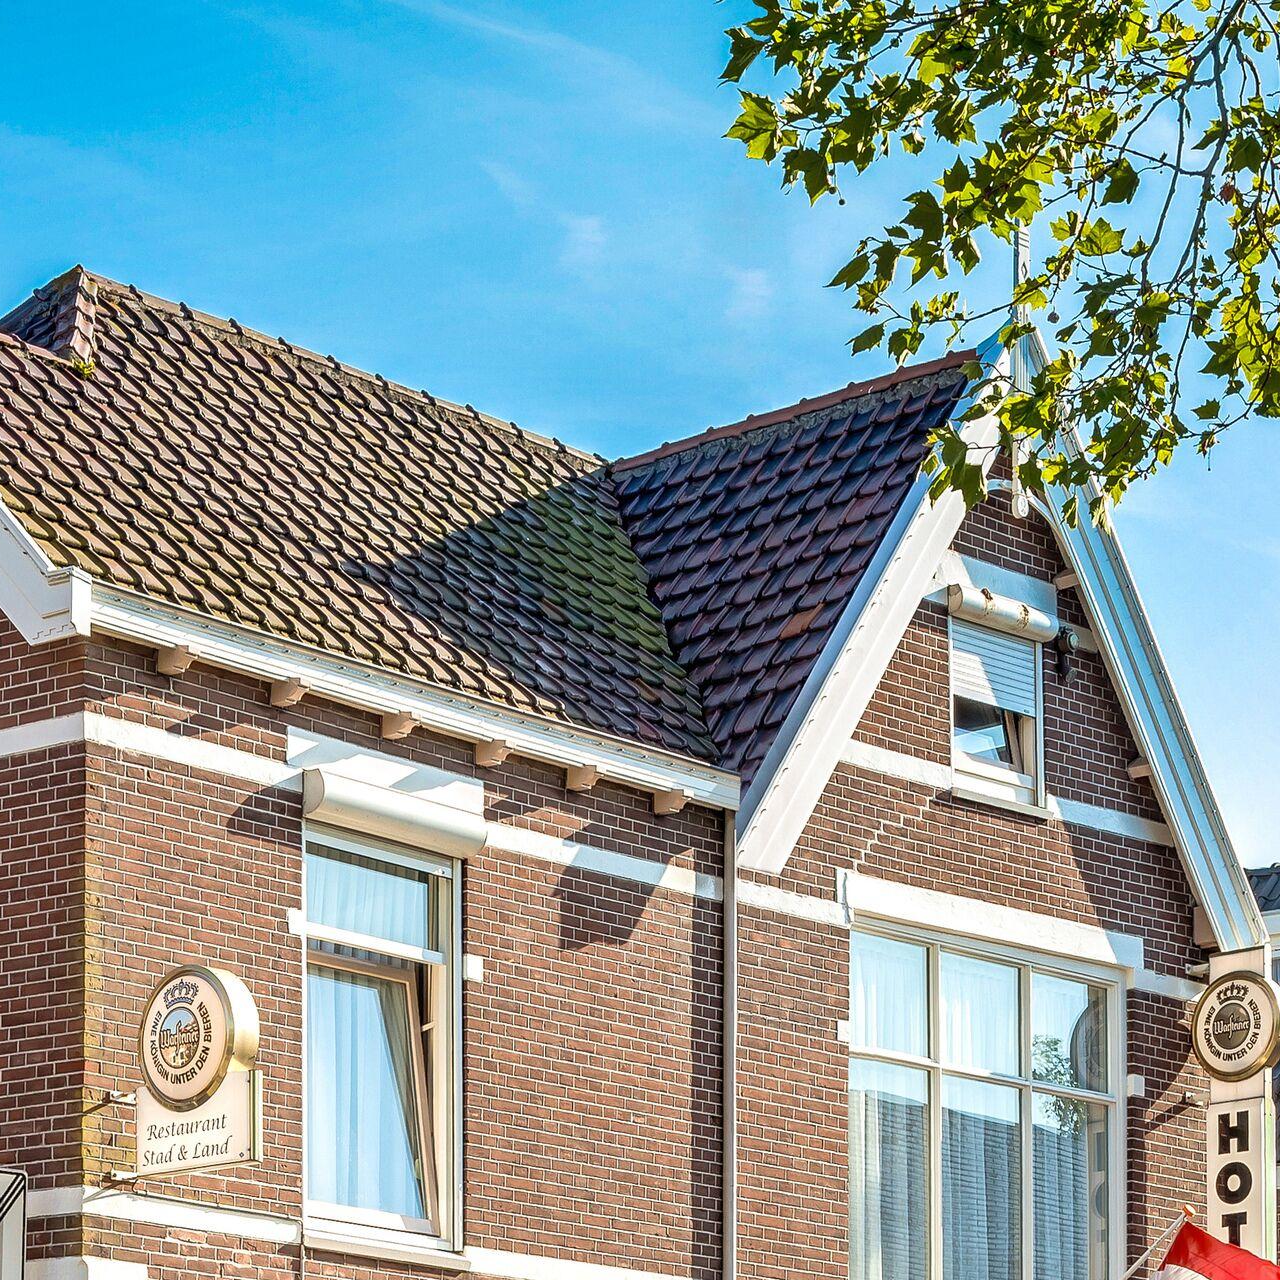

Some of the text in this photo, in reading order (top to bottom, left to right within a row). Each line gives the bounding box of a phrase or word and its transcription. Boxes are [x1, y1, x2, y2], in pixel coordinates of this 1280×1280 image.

[150, 1002, 212, 1084] EINE KÖNIGIN UNTER DEN BIEREN
[1204, 998, 1261, 1061] EINE KÖNIGIN UNTER DEN BIEREN
[147, 1114, 228, 1140] Restaurant
[142, 1135, 233, 1167] Stad & Land
